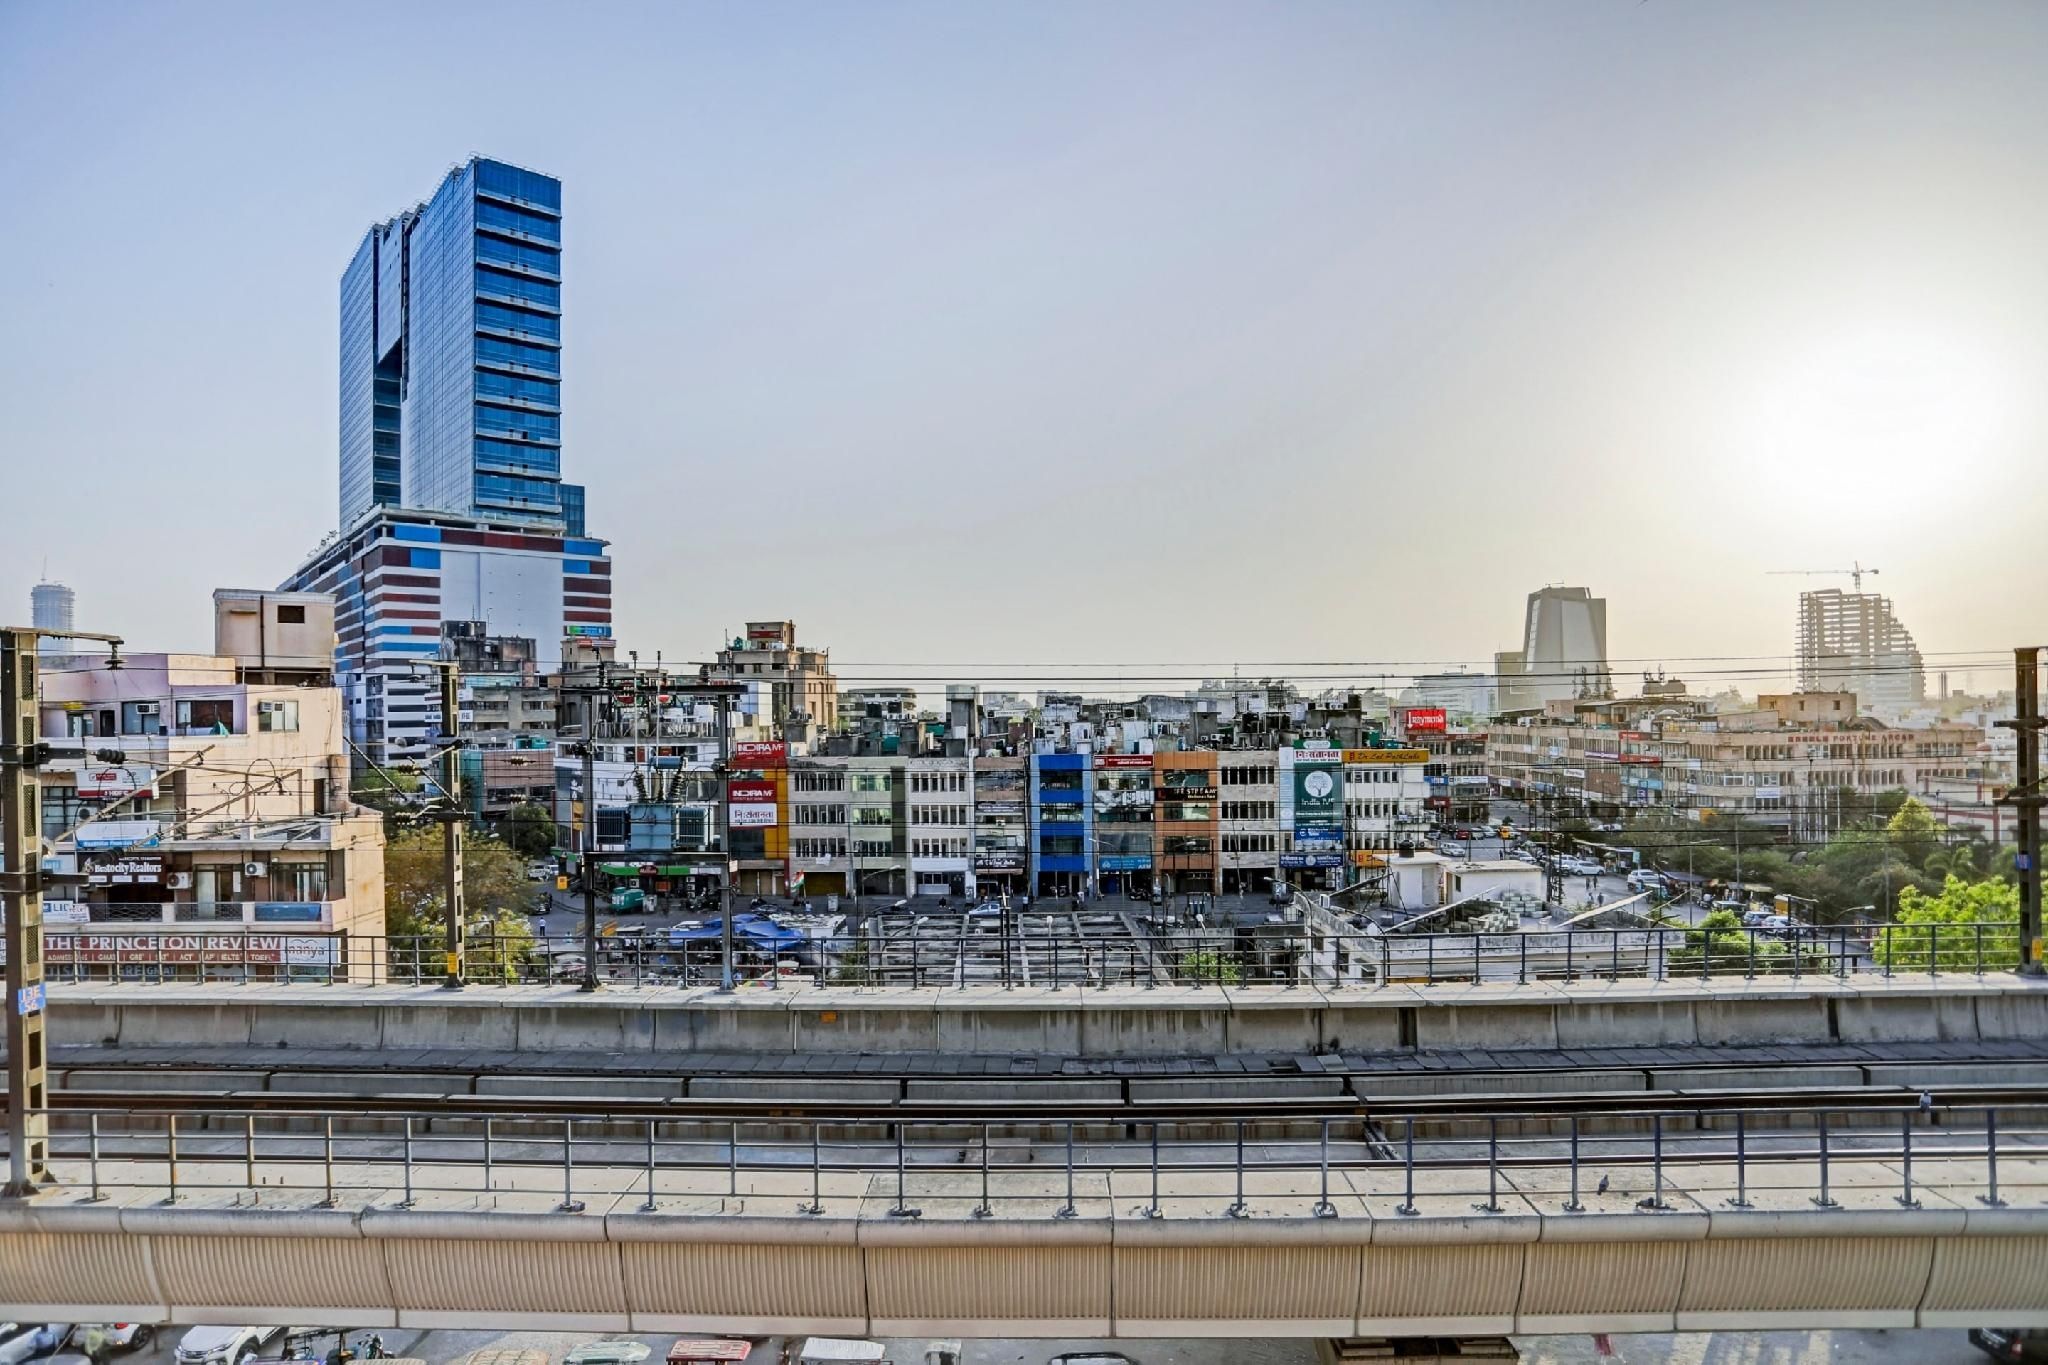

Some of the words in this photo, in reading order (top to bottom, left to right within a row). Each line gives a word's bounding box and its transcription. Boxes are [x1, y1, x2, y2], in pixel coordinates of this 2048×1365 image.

[738, 743, 771, 751] INDIRA
[130, 861, 161, 873] Realtors
[45, 937, 81, 950] THE
[89, 936, 199, 950] PRINCETON
[207, 936, 279, 950] REVEW
